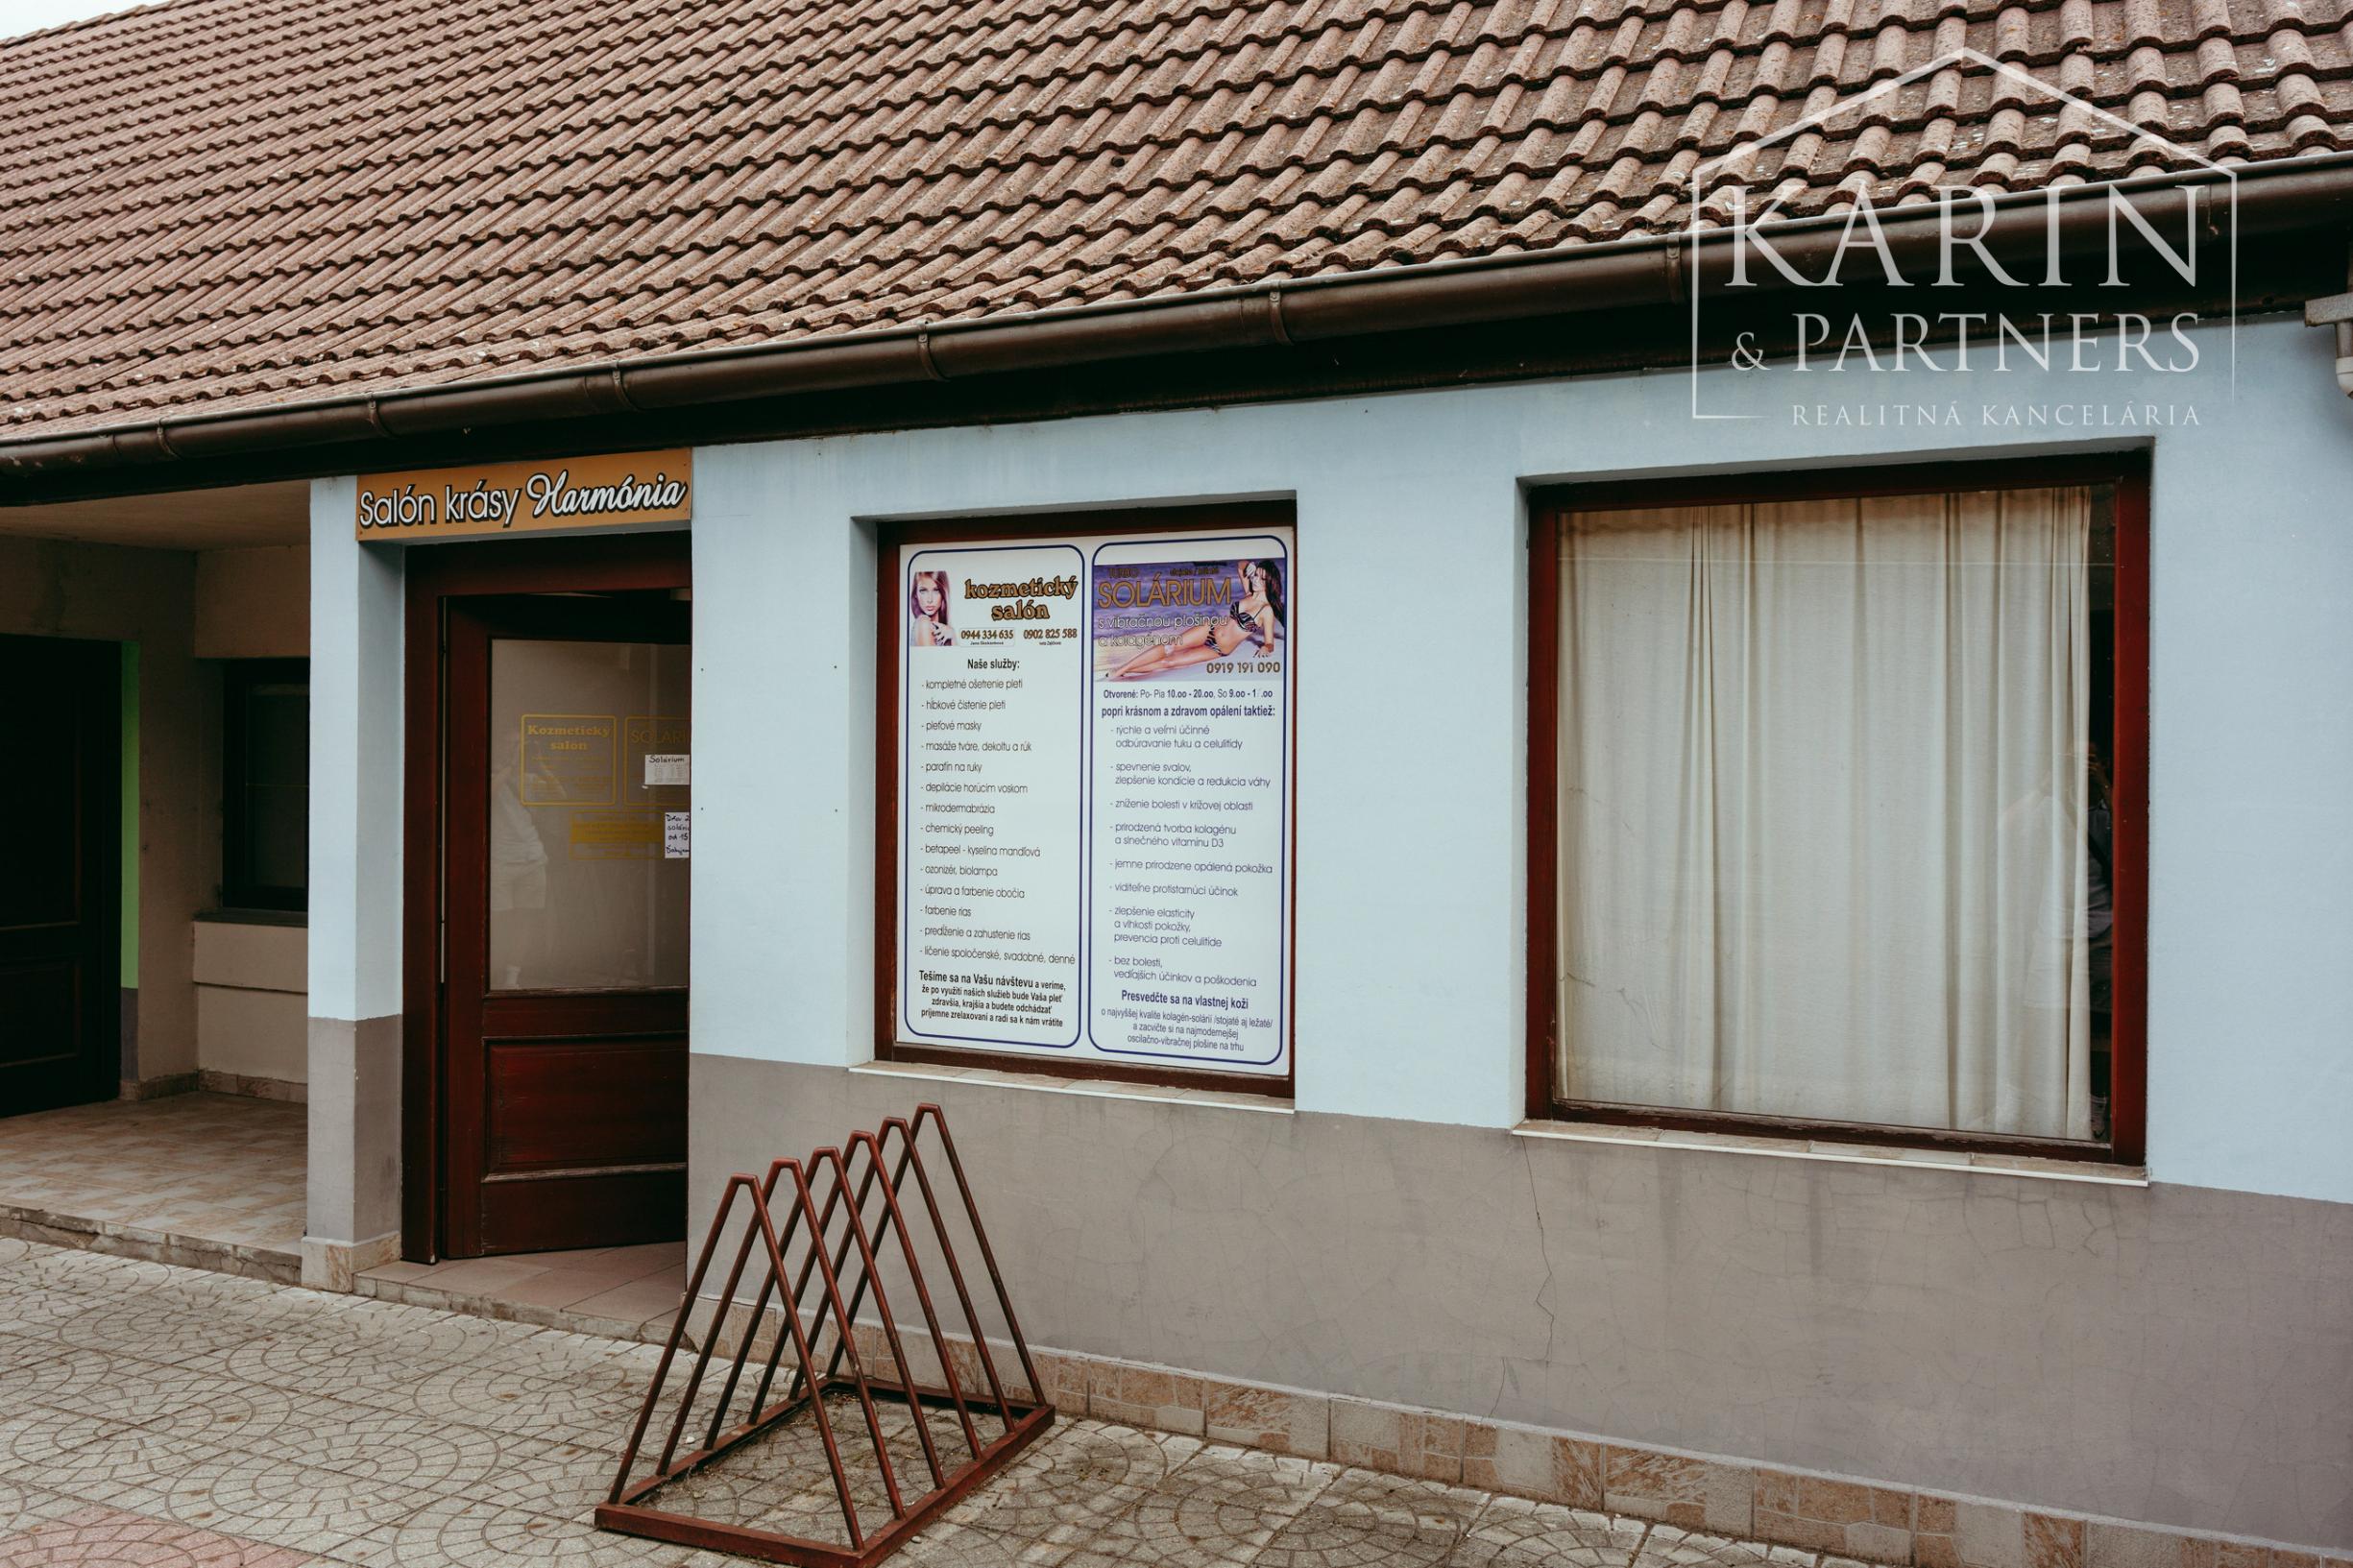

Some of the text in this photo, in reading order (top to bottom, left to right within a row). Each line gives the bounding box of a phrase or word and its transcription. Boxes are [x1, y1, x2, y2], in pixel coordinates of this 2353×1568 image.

[358, 470, 689, 528] Salón krásy Harmónia
[964, 575, 1078, 600] kozmetický
[1098, 571, 1231, 609] SOLÁRIUM
[991, 599, 1050, 621] salón
[1099, 614, 1227, 629] s vibračnou plošinou
[961, 630, 1013, 639] 0944 334 635
[1023, 629, 1077, 639] 0902 825 588
[1110, 633, 1183, 649] kolagénom
[968, 659, 1020, 671] Naše služby:
[1206, 662, 1280, 674] 0919 191 090
[926, 680, 1023, 689] kompletné ošetrenie pleti
[1104, 689, 1138, 699] Otvorené:
[958, 700, 987, 710] čistenie
[989, 701, 1006, 711] pleti
[1102, 705, 1274, 718] popri krásnom zdravom opálení taktiež:
[926, 720, 982, 732] pleťové masky
[1116, 725, 1209, 736] rýchle veľmi účinné
[926, 741, 956, 751] masáže
[982, 741, 1010, 751] dekoltu
[1021, 742, 1031, 751] rúk
[1116, 738, 1171, 747] odbúravanie
[967, 763, 982, 773] ruky
[1116, 762, 1160, 772] spevnenie
[1115, 775, 1155, 785] zlepšenie
[1206, 777, 1246, 785] redukcia
[1249, 777, 1271, 788] váhy
[926, 783, 961, 793] depilácie
[926, 804, 995, 813] mikrodermabrázia
[1116, 799, 1149, 808] zníženie
[1152, 800, 1180, 808] bolesti
[1224, 802, 1252, 810] oblasti
[925, 823, 994, 836] chemický peeling
[1116, 822, 1236, 836] prirodzená tvorba kolagénu
[1124, 835, 1169, 846] slnečného
[1211, 838, 1224, 847] D3
[925, 845, 960, 855] betapeel
[968, 846, 997, 856] kyselina
[959, 865, 998, 877] biolampa
[1115, 859, 1273, 875] jemne prirodzene opálená pokožka
[925, 884, 1025, 898] úprava farbenie obočia
[1208, 886, 1238, 896] účinok
[925, 905, 971, 916] farbenie rias
[1114, 906, 1154, 917] zlepšenie
[1123, 920, 1152, 929] vlhkosti
[974, 929, 1015, 939] zahustenie
[1018, 931, 1031, 940] rias
[1114, 933, 1158, 944] prevencia
[1160, 935, 1180, 946] proti
[952, 948, 1002, 960] spoločenské,
[1005, 952, 1046, 963] svadobné,
[1049, 954, 1076, 964] denné
[1115, 956, 1129, 965] bez
[919, 970, 947, 981] Tešíme
[973, 974, 993, 984] Vašu
[996, 976, 1032, 987] návštevu
[1159, 972, 1192, 982] účinkov
[1204, 976, 1256, 987] poškodenia
[987, 989, 1010, 999] služieb
[1012, 991, 1029, 1000] bude
[1031, 991, 1047, 1001] Vaša
[1049, 994, 1063, 1002] pleť
[1122, 990, 1249, 1010] Presvedčte vlastnej koži
[932, 998, 1052, 1014] zdravšia, krajšia budete odchádzať
[995, 1014, 1007, 1023] radi
[1107, 1009, 1138, 1019] najvyššej
[1139, 1024, 1239, 1040] zacvičte najmodernejšej
[1128, 1034, 1244, 1051] oscilačno-vibračnej plošine trhu
